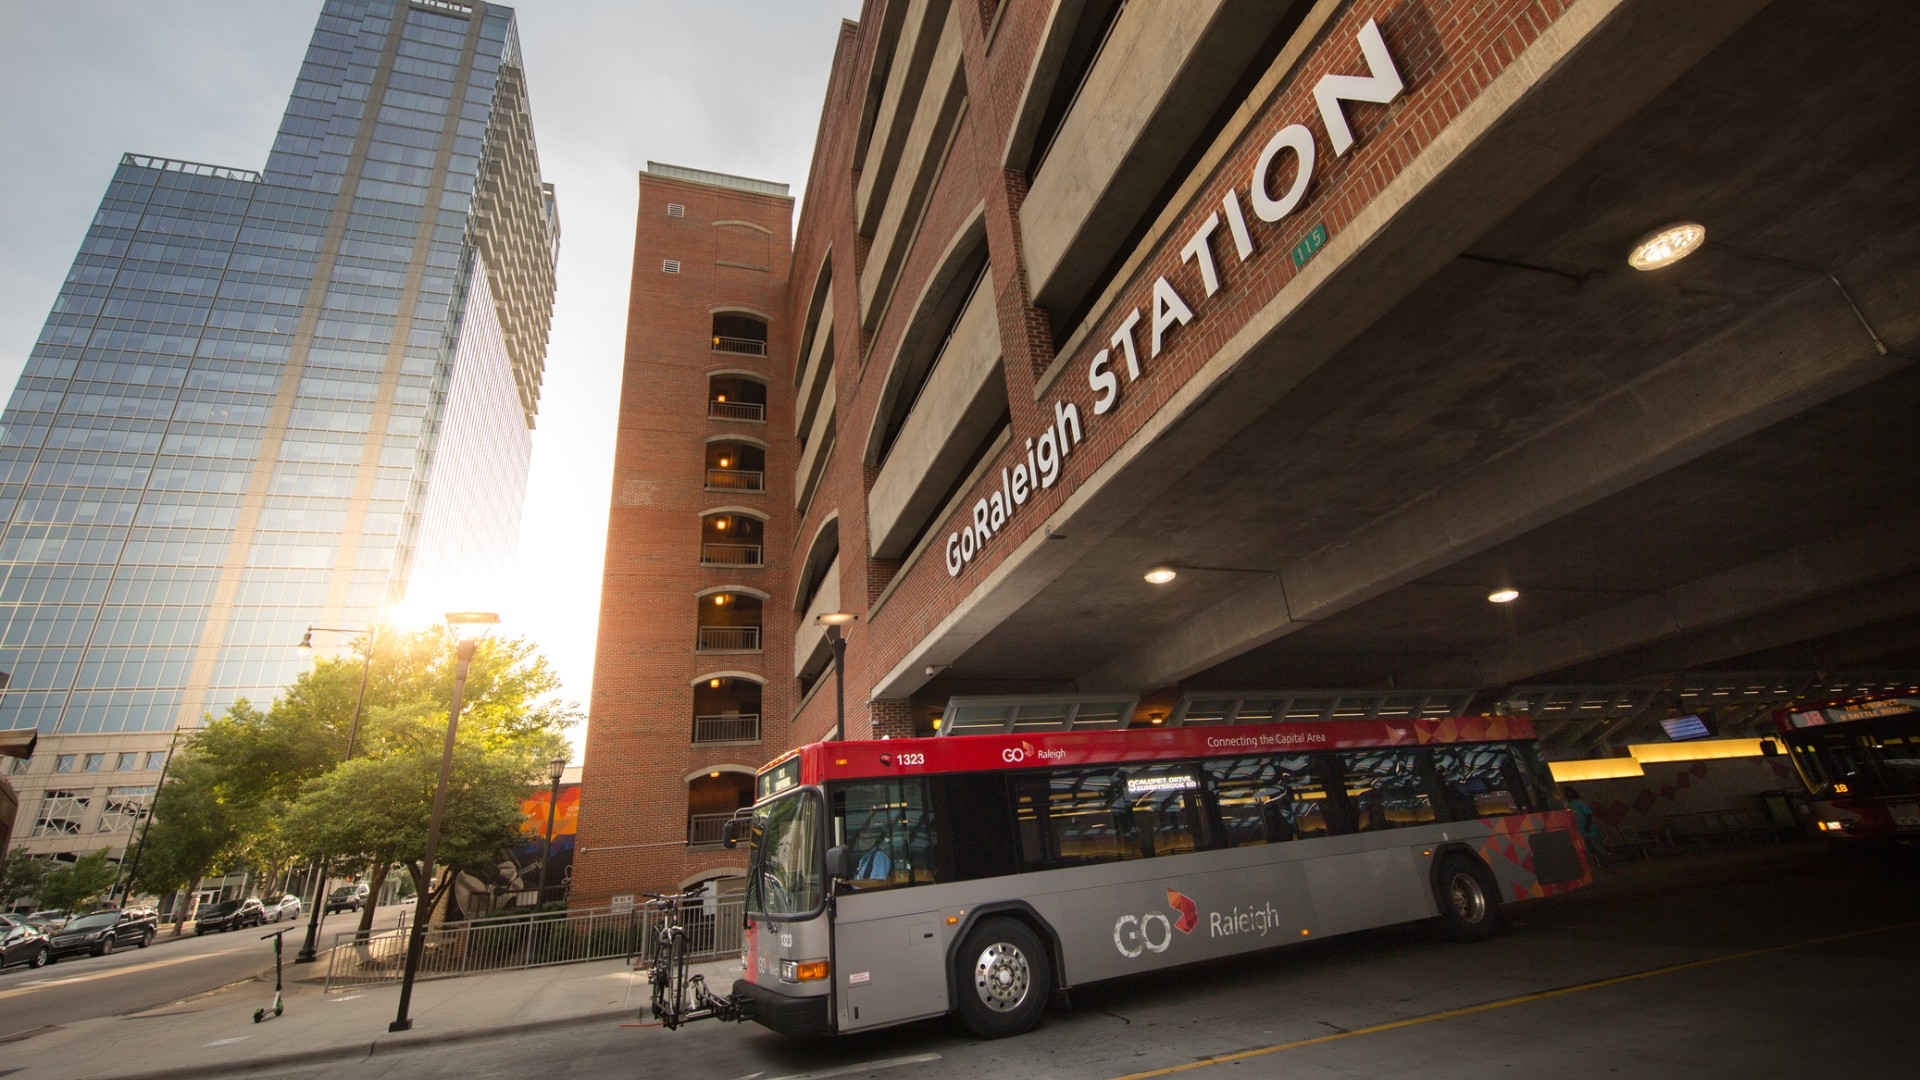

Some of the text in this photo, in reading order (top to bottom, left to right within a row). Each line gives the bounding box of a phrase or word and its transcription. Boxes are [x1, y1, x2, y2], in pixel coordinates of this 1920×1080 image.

[1297, 229, 1321, 261] 115
[946, 18, 1403, 577] GoRaleigh STATION
[1803, 710, 1825, 725] 18
[1848, 710, 1879, 720] BATTLE
[1881, 705, 1913, 715] BRIDGE
[1207, 733, 1326, 748] Connecting the Capital Area
[896, 753, 925, 765] 1323
[1002, 748, 1066, 763] GO Raleigh
[1833, 783, 1848, 794] 18
[1113, 901, 1280, 958] GO Raleigh
[780, 933, 792, 947] 1323
